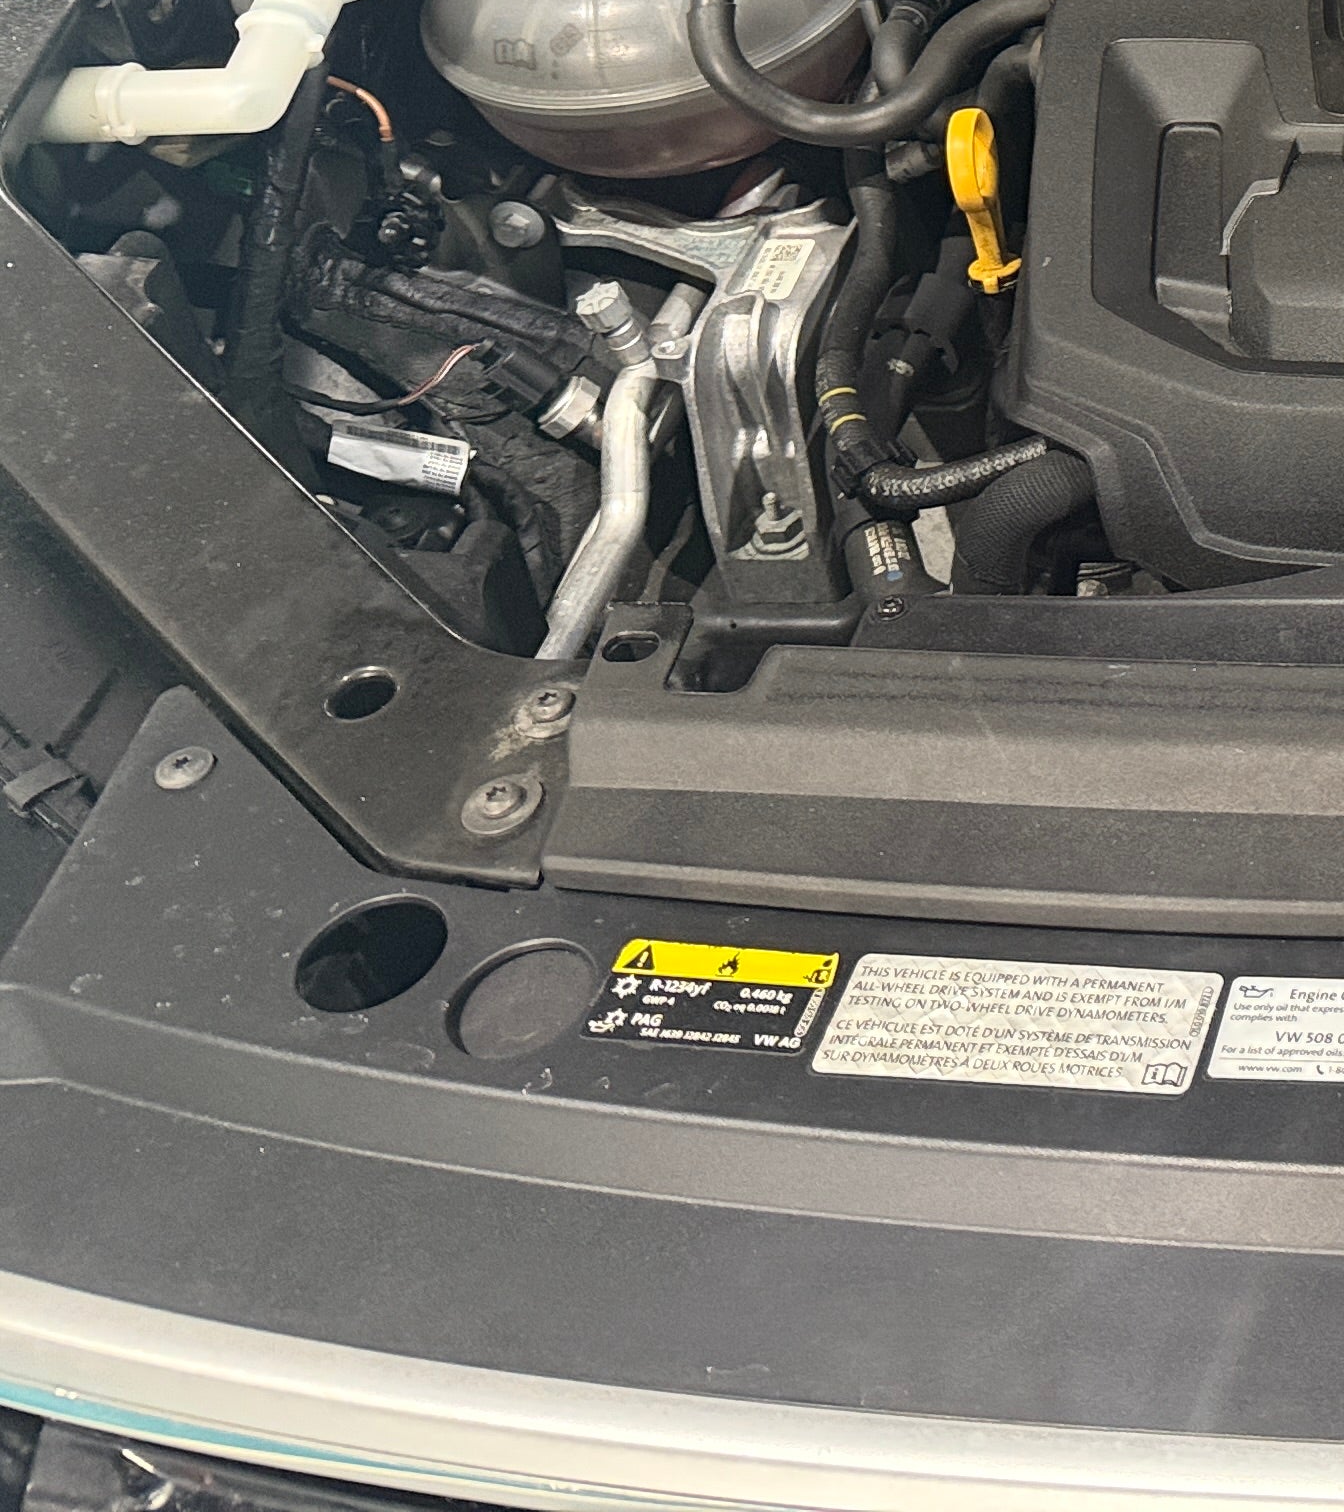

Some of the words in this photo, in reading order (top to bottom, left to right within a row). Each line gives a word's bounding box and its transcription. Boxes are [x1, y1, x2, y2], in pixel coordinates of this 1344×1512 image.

[861, 966, 891, 977] THIS
[893, 967, 945, 980] VEHICLE
[950, 971, 961, 981] IS
[964, 971, 1029, 985] EQUIPPED
[1033, 975, 1068, 987] WITH
[1070, 978, 1080, 987] A
[1082, 979, 1165, 993] PERMANENT
[649, 979, 712, 997] R-1234yf
[852, 981, 925, 994] ALL-WHEEL
[929, 985, 967, 996] DRIVE
[971, 987, 1019, 999] SYSTEM
[1021, 990, 1053, 1002] AND
[1056, 992, 1067, 1002] IS
[1070, 993, 1121, 1006] EXEMPT
[1123, 996, 1162, 1007] FROM
[777, 992, 793, 1004] kg
[1290, 989, 1337, 1003] Engine
[849, 995, 901, 1009] TESTING
[905, 998, 927, 1009] ON
[930, 999, 1011, 1015] TWO-WHEEL
[1014, 1005, 1055, 1016] DRIVE
[1234, 1003, 1250, 1011] Use
[1253, 1004, 1274, 1013] only
[1276, 1004, 1288, 1012] oil
[1290, 1004, 1310, 1013] that
[630, 1013, 664, 1026] PAG
[1230, 1013, 1273, 1023] complies
[1276, 1014, 1298, 1022] with
[754, 1034, 779, 1047] VW
[778, 1035, 801, 1048] AG
[836, 1019, 853, 1030] CE
[856, 1018, 917, 1034] VÉHICULE
[920, 1024, 944, 1035] EST
[945, 1023, 979, 1037] DOTÉ
[982, 1027, 1016, 1039] D'UN
[1018, 1029, 1073, 1043] SYSTÈME
[1075, 1033, 1091, 1044] DE
[1094, 1033, 1192, 1050] TRANSMISSION
[1275, 1031, 1303, 1043] VW
[1306, 1032, 1333, 1044] 508
[829, 1034, 897, 1049] INTÉGRALE
[900, 1038, 977, 1053] PERMANENT
[978, 1042, 993, 1054] ET
[1054, 1046, 1107, 1060] D'ESSAIS
[1220, 1045, 1237, 1054] For
[1247, 1046, 1262, 1055] list
[1264, 1047, 1275, 1055] of
[1277, 1048, 1323, 1057] approved
[823, 1049, 850, 1061] SUR
[851, 1050, 958, 1068] DYNAMOMÈTRES
[973, 1058, 1008, 1070] DEUX
[1012, 1060, 1056, 1074] ROUES
